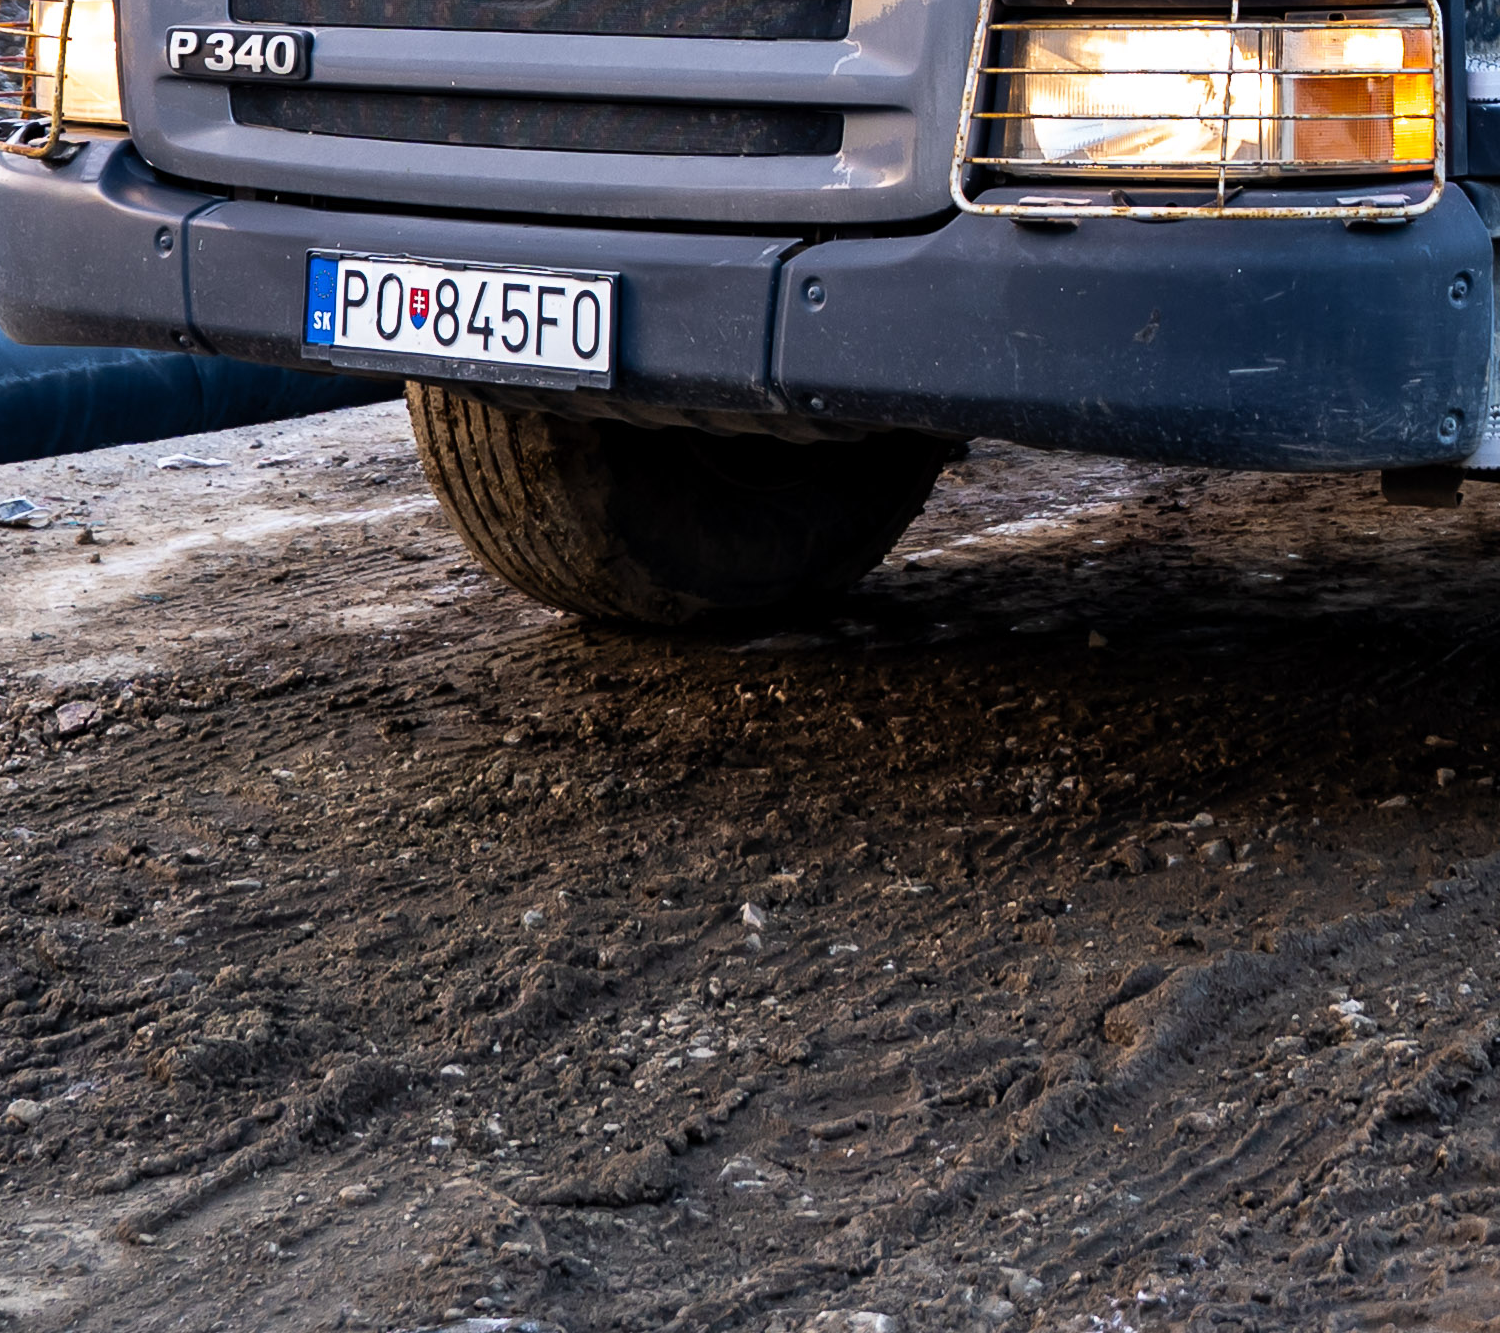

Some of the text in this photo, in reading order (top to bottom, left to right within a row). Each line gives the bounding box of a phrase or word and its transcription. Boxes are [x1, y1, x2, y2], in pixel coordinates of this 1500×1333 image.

[169, 31, 296, 75] P 340
[313, 310, 332, 331] SK
